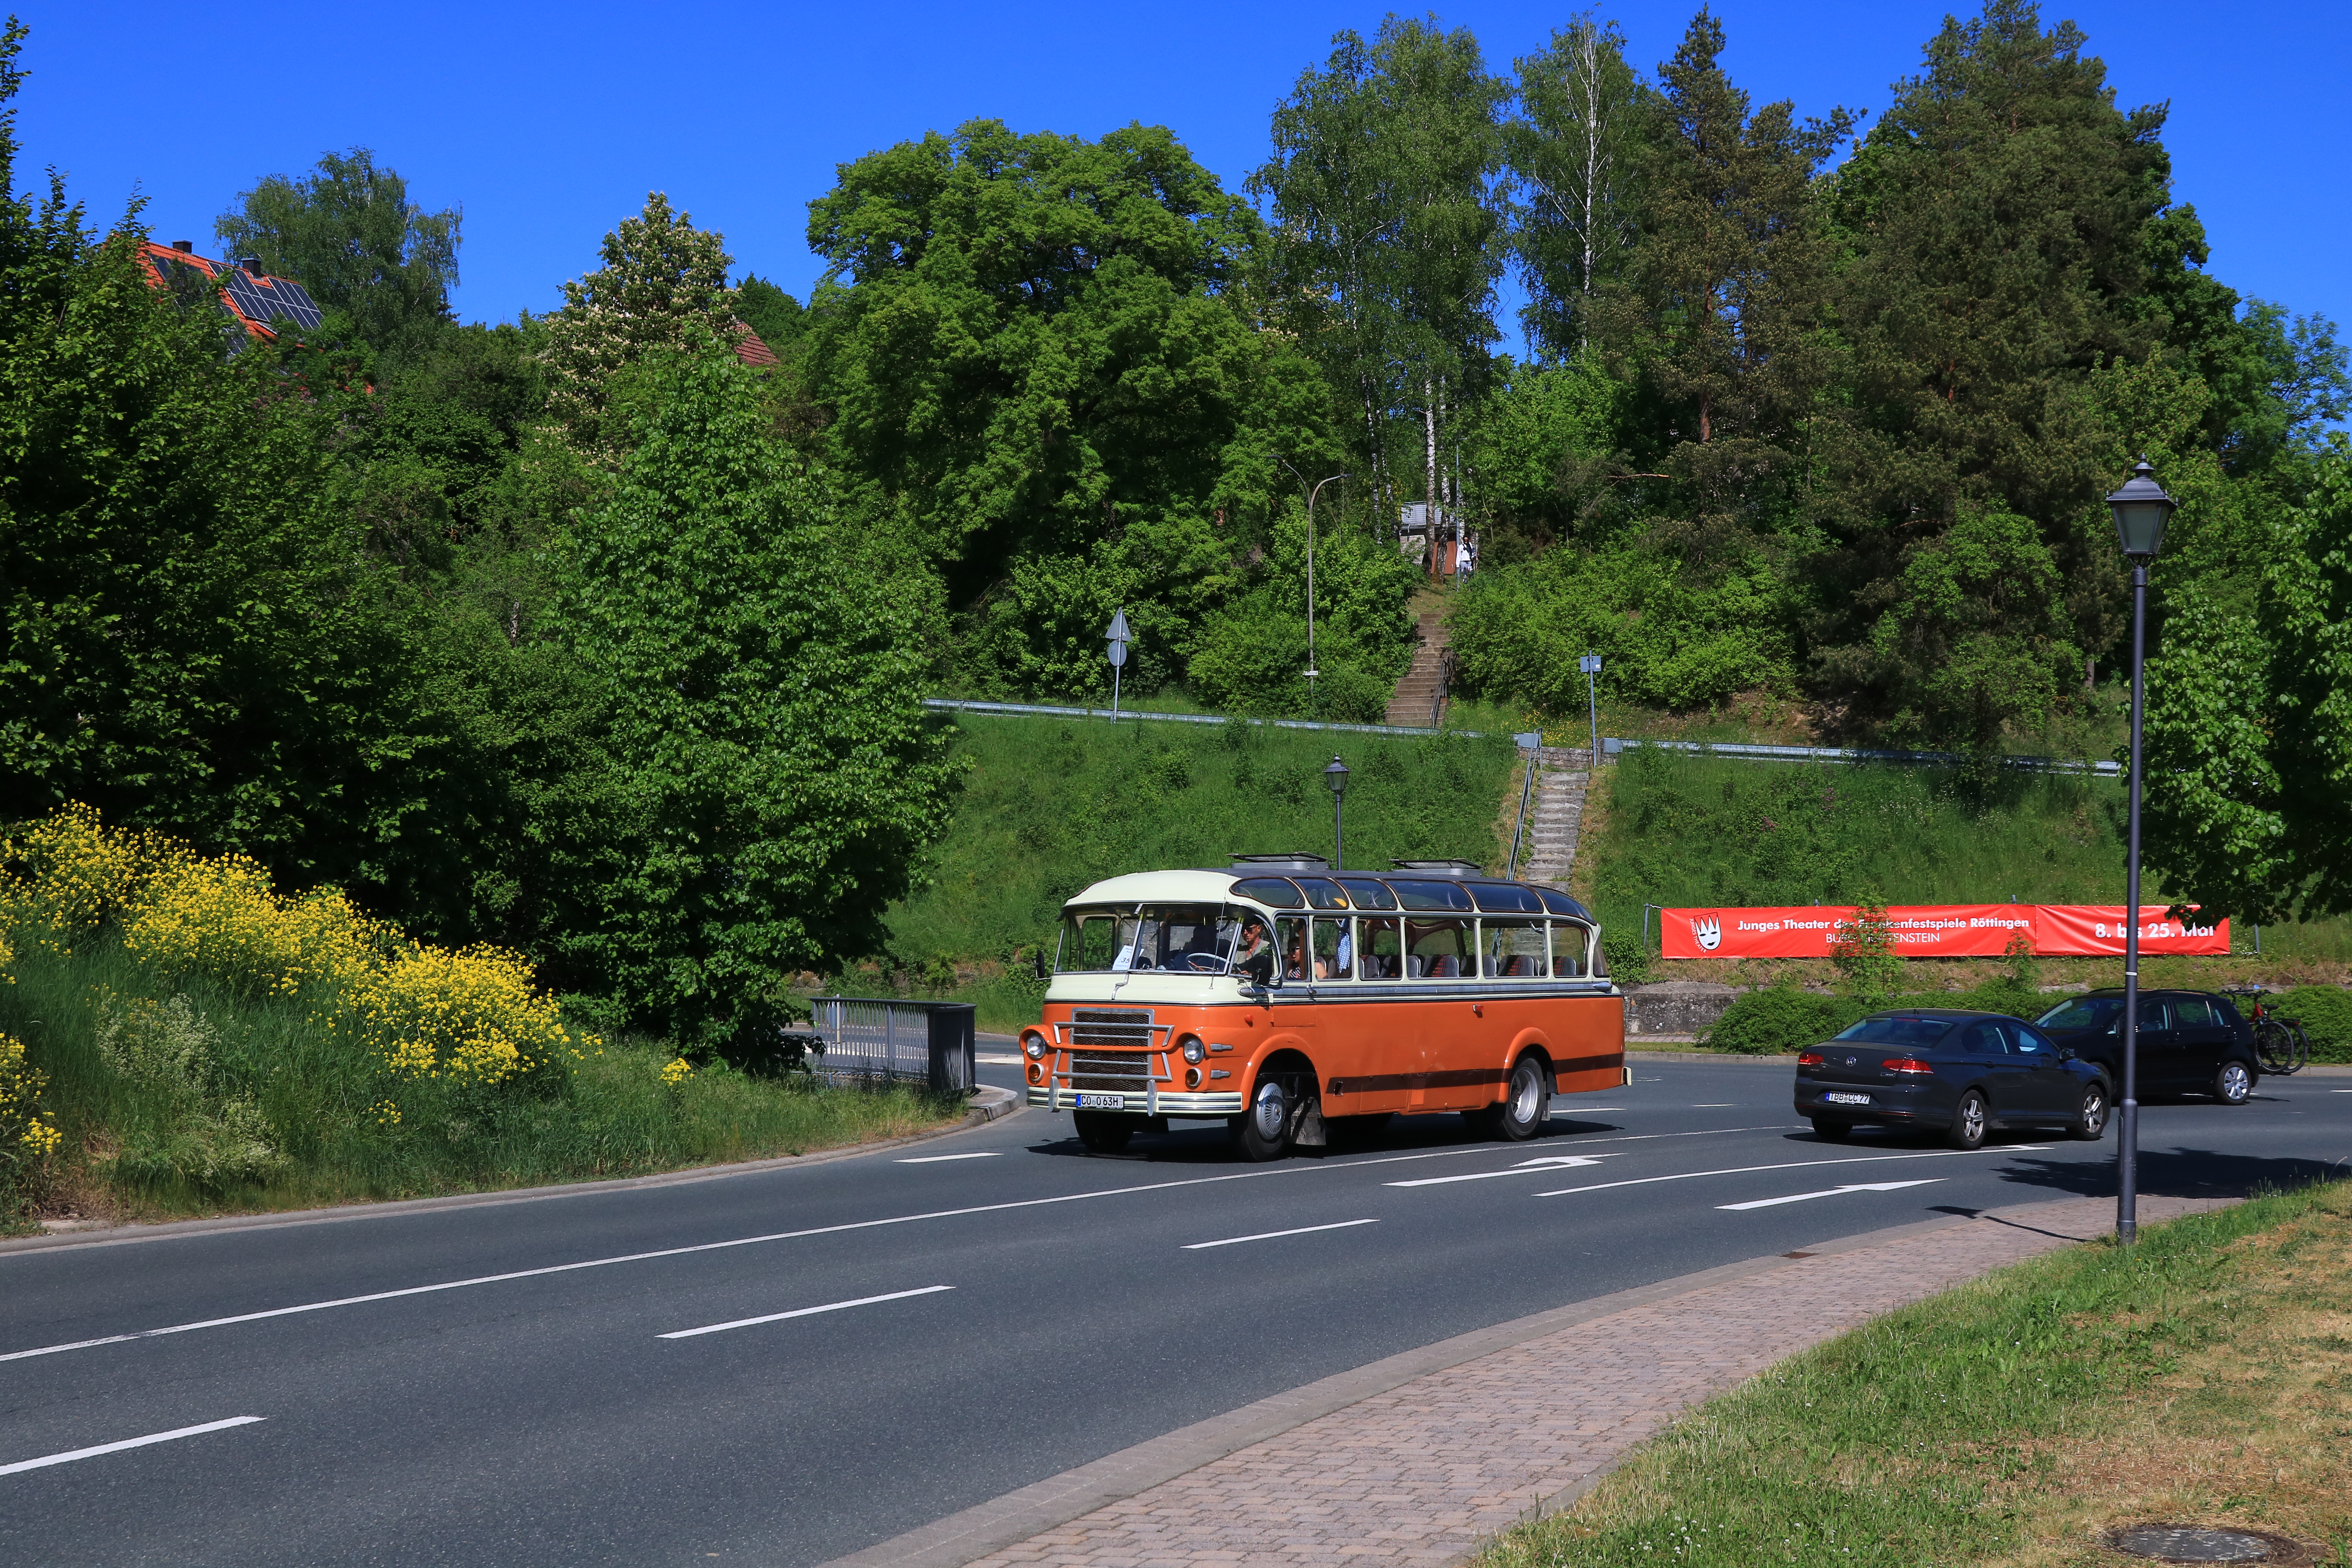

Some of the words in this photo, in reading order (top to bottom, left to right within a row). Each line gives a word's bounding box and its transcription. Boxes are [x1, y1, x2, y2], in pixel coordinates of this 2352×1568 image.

[1737, 920, 1780, 932] Junges
[1783, 919, 1830, 929] Theater
[1970, 917, 2029, 929] Röttingen
[2095, 923, 2111, 938] 8.
[2117, 922, 2143, 938] bs
[2147, 923, 2175, 938] 25.
[1693, 936, 1707, 953] THEATER
[1082, 1096, 1091, 1105] CO
[1103, 1097, 1118, 1106] 63H
